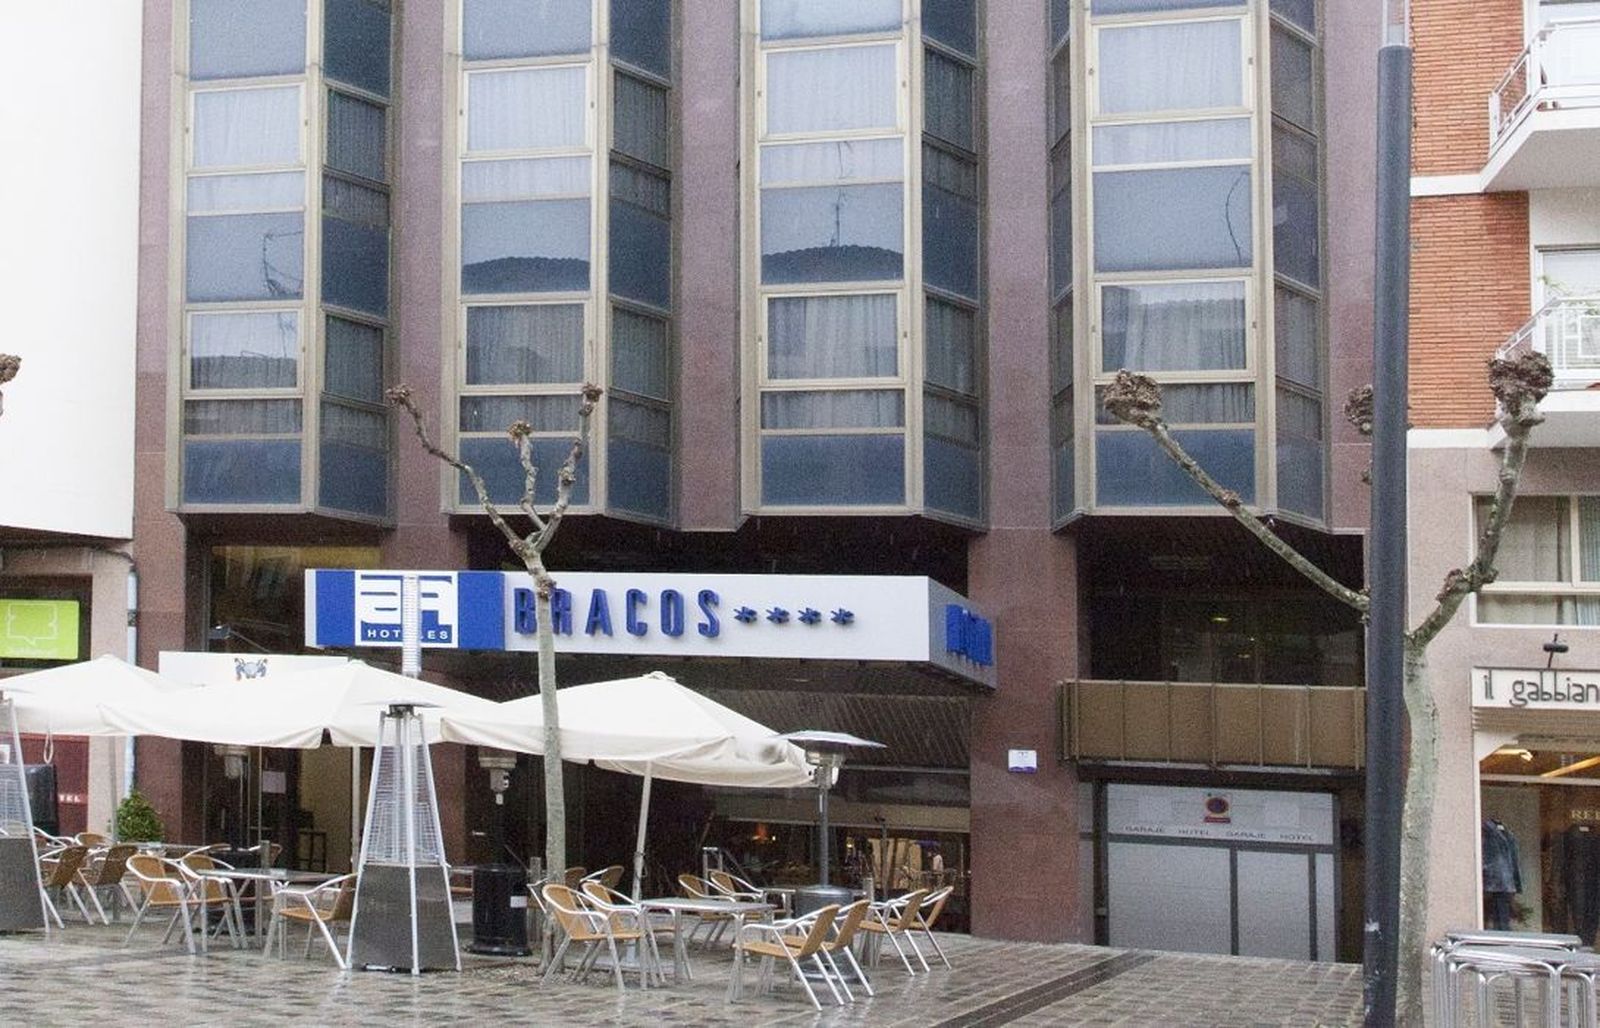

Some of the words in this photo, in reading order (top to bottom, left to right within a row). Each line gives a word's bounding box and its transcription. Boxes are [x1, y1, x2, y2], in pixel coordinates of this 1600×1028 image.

[514, 588, 720, 638] BRACOS
[367, 629, 449, 640] HOTES
[1484, 670, 1494, 700] il
[1125, 825, 1165, 834] GARAJE
[1178, 828, 1209, 837] HOTEL
